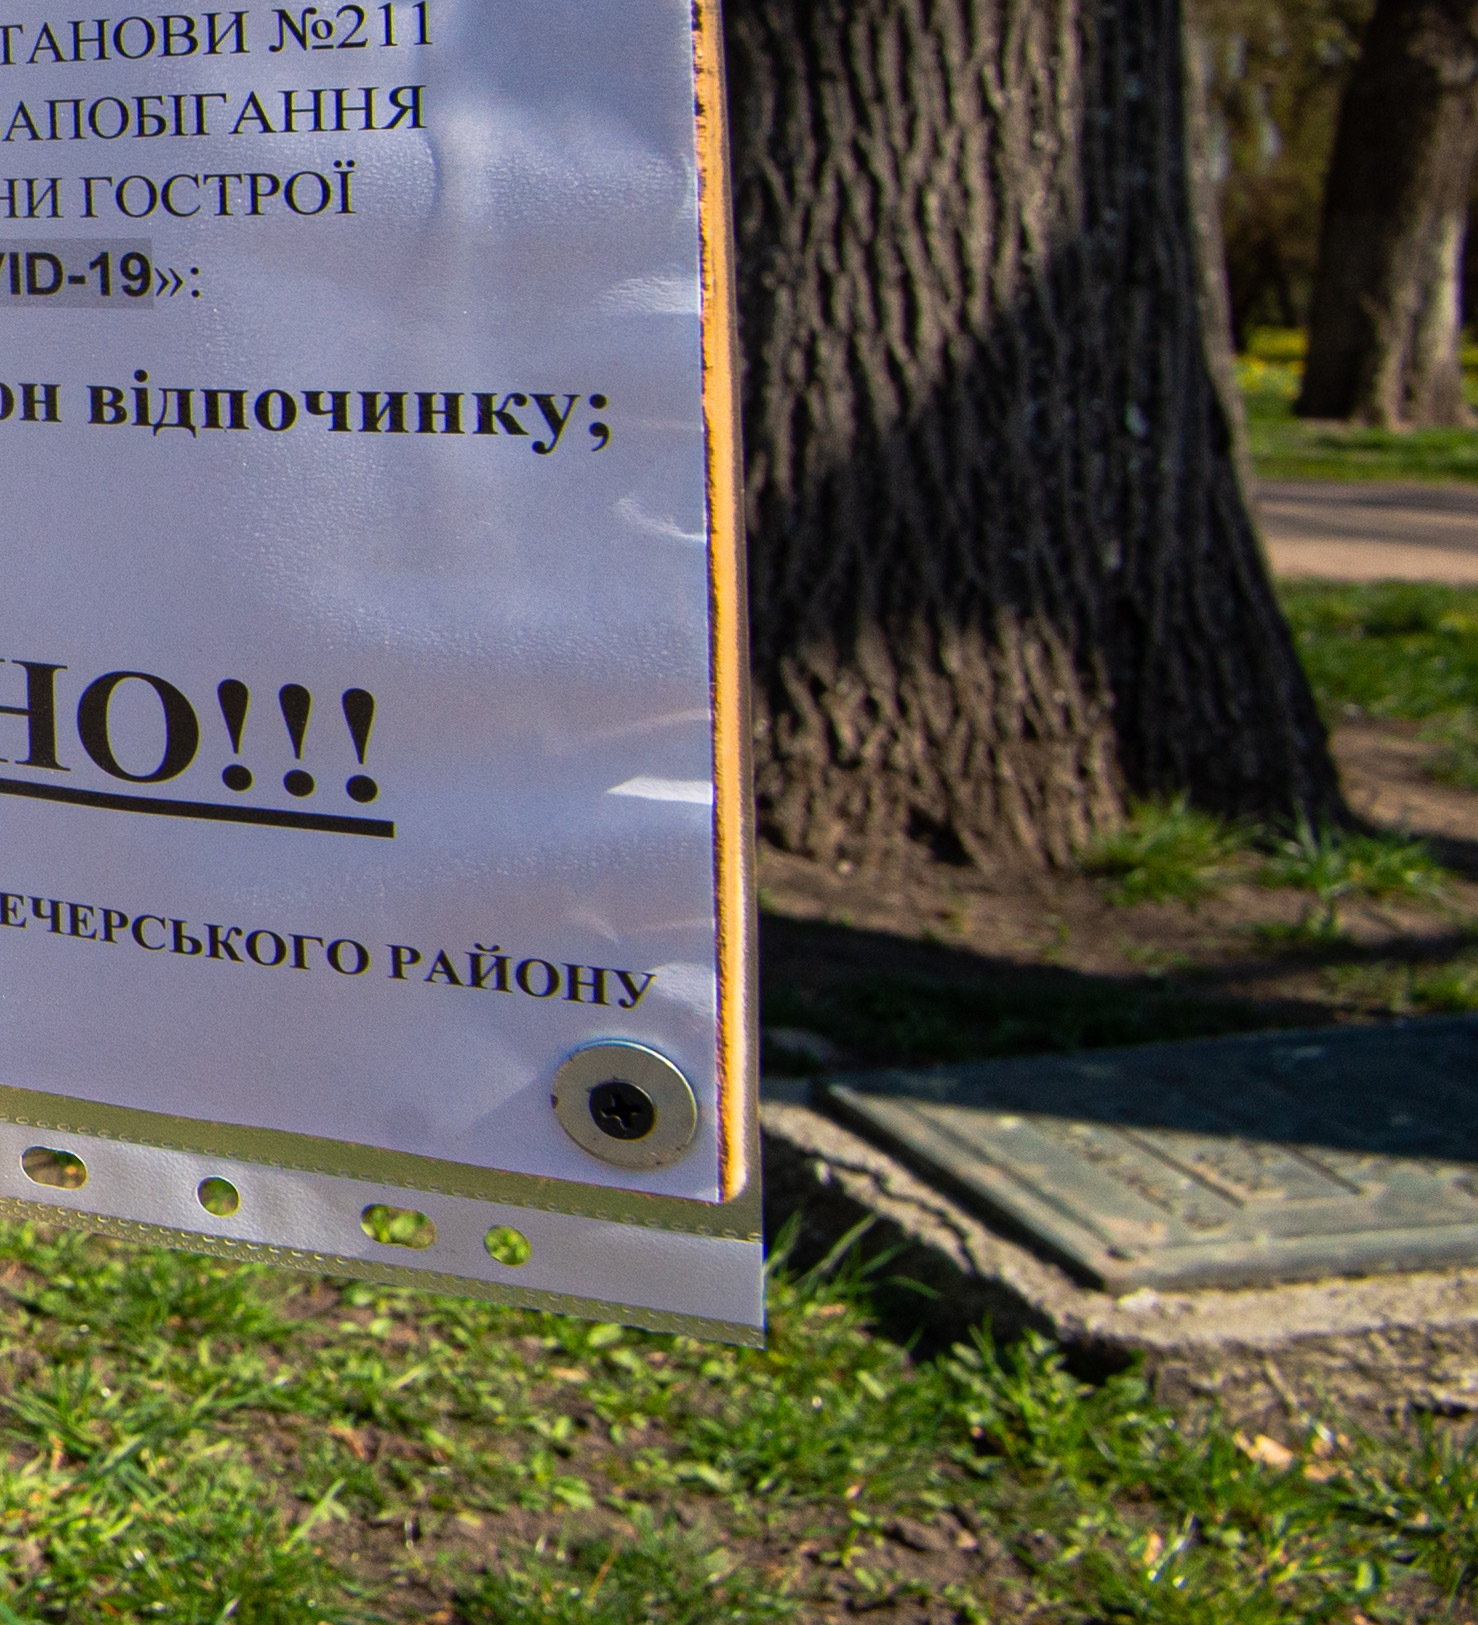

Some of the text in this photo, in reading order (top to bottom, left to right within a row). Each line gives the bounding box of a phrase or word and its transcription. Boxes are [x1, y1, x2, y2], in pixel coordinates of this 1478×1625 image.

[269, 1, 432, 52] №211
[80, 160, 356, 218] ГОСТРОЇ
[87, 370, 609, 454] відпочинку;
[387, 943, 655, 1008] РАЙОНУ
